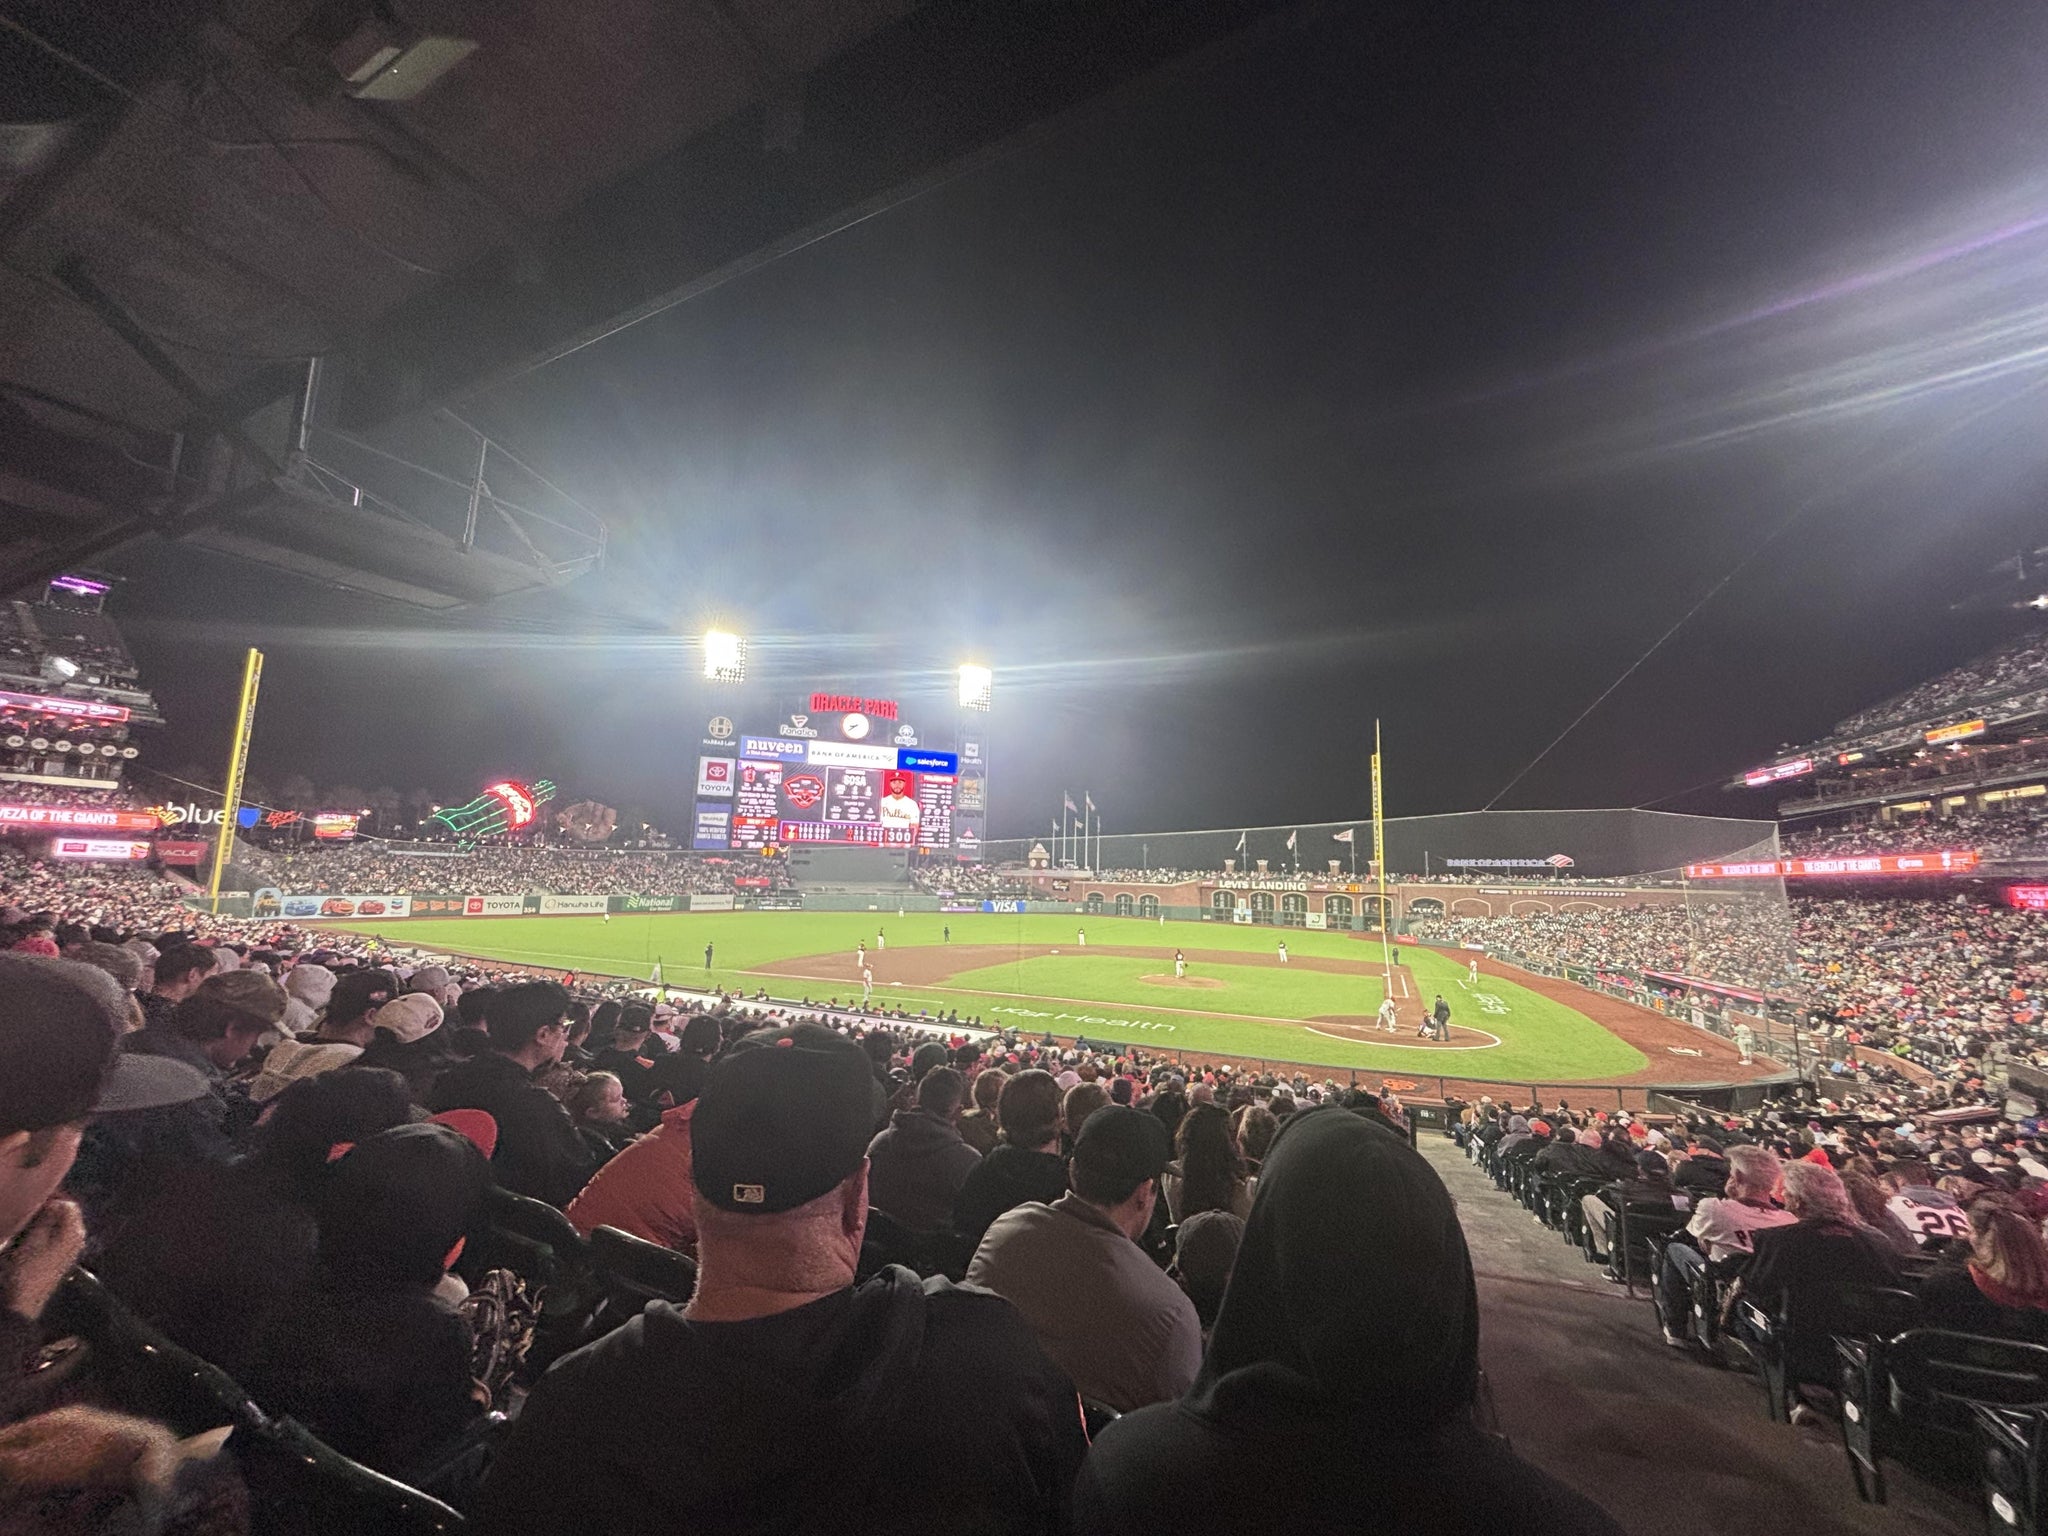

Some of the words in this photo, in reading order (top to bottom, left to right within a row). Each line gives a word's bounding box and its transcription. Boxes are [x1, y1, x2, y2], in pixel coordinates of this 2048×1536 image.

[810, 692, 861, 712] ORACLE
[864, 699, 898, 720] PARK
[781, 725, 817, 737] Fanatics
[747, 740, 803, 754] nuveen
[846, 753, 880, 761] AMERICA
[917, 758, 948, 767] salesforce
[844, 776, 867, 786] SOSA
[700, 784, 731, 792] TOYOTA
[30, 809, 47, 820] OF
[49, 809, 72, 822] THE
[73, 811, 117, 824] GIANTS
[167, 802, 226, 825] blue
[1252, 881, 1307, 891] LANDING
[486, 901, 520, 909] TOYOTA
[639, 898, 673, 907] National
[992, 900, 1018, 912] VISA
[1054, 1013, 1176, 1032] Health
